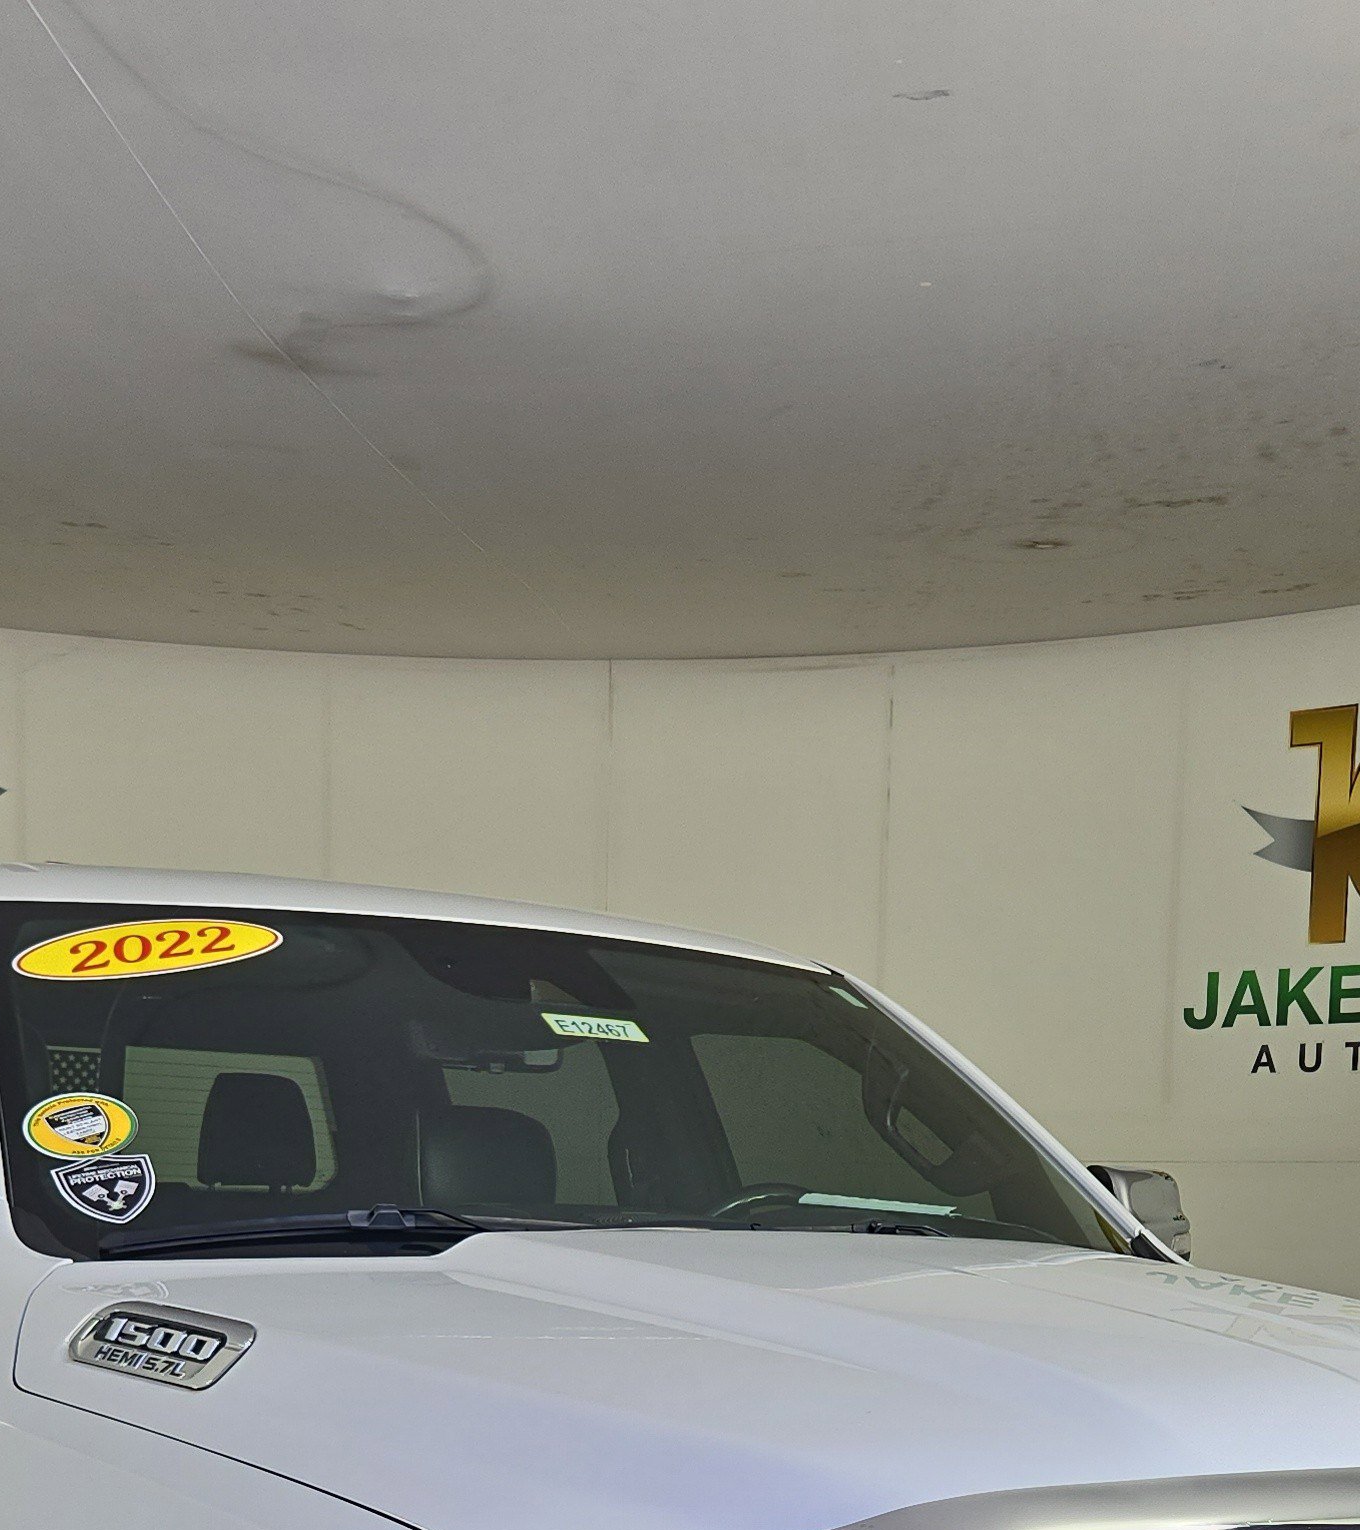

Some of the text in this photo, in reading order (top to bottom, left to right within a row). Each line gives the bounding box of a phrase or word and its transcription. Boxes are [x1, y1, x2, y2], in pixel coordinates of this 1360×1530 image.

[69, 926, 236, 973] 2022
[554, 1019, 630, 1038] E12467
[68, 1166, 142, 1187] PROTECTION
[103, 1316, 221, 1361] 1500
[93, 1344, 186, 1380] HEMI 5.7L
